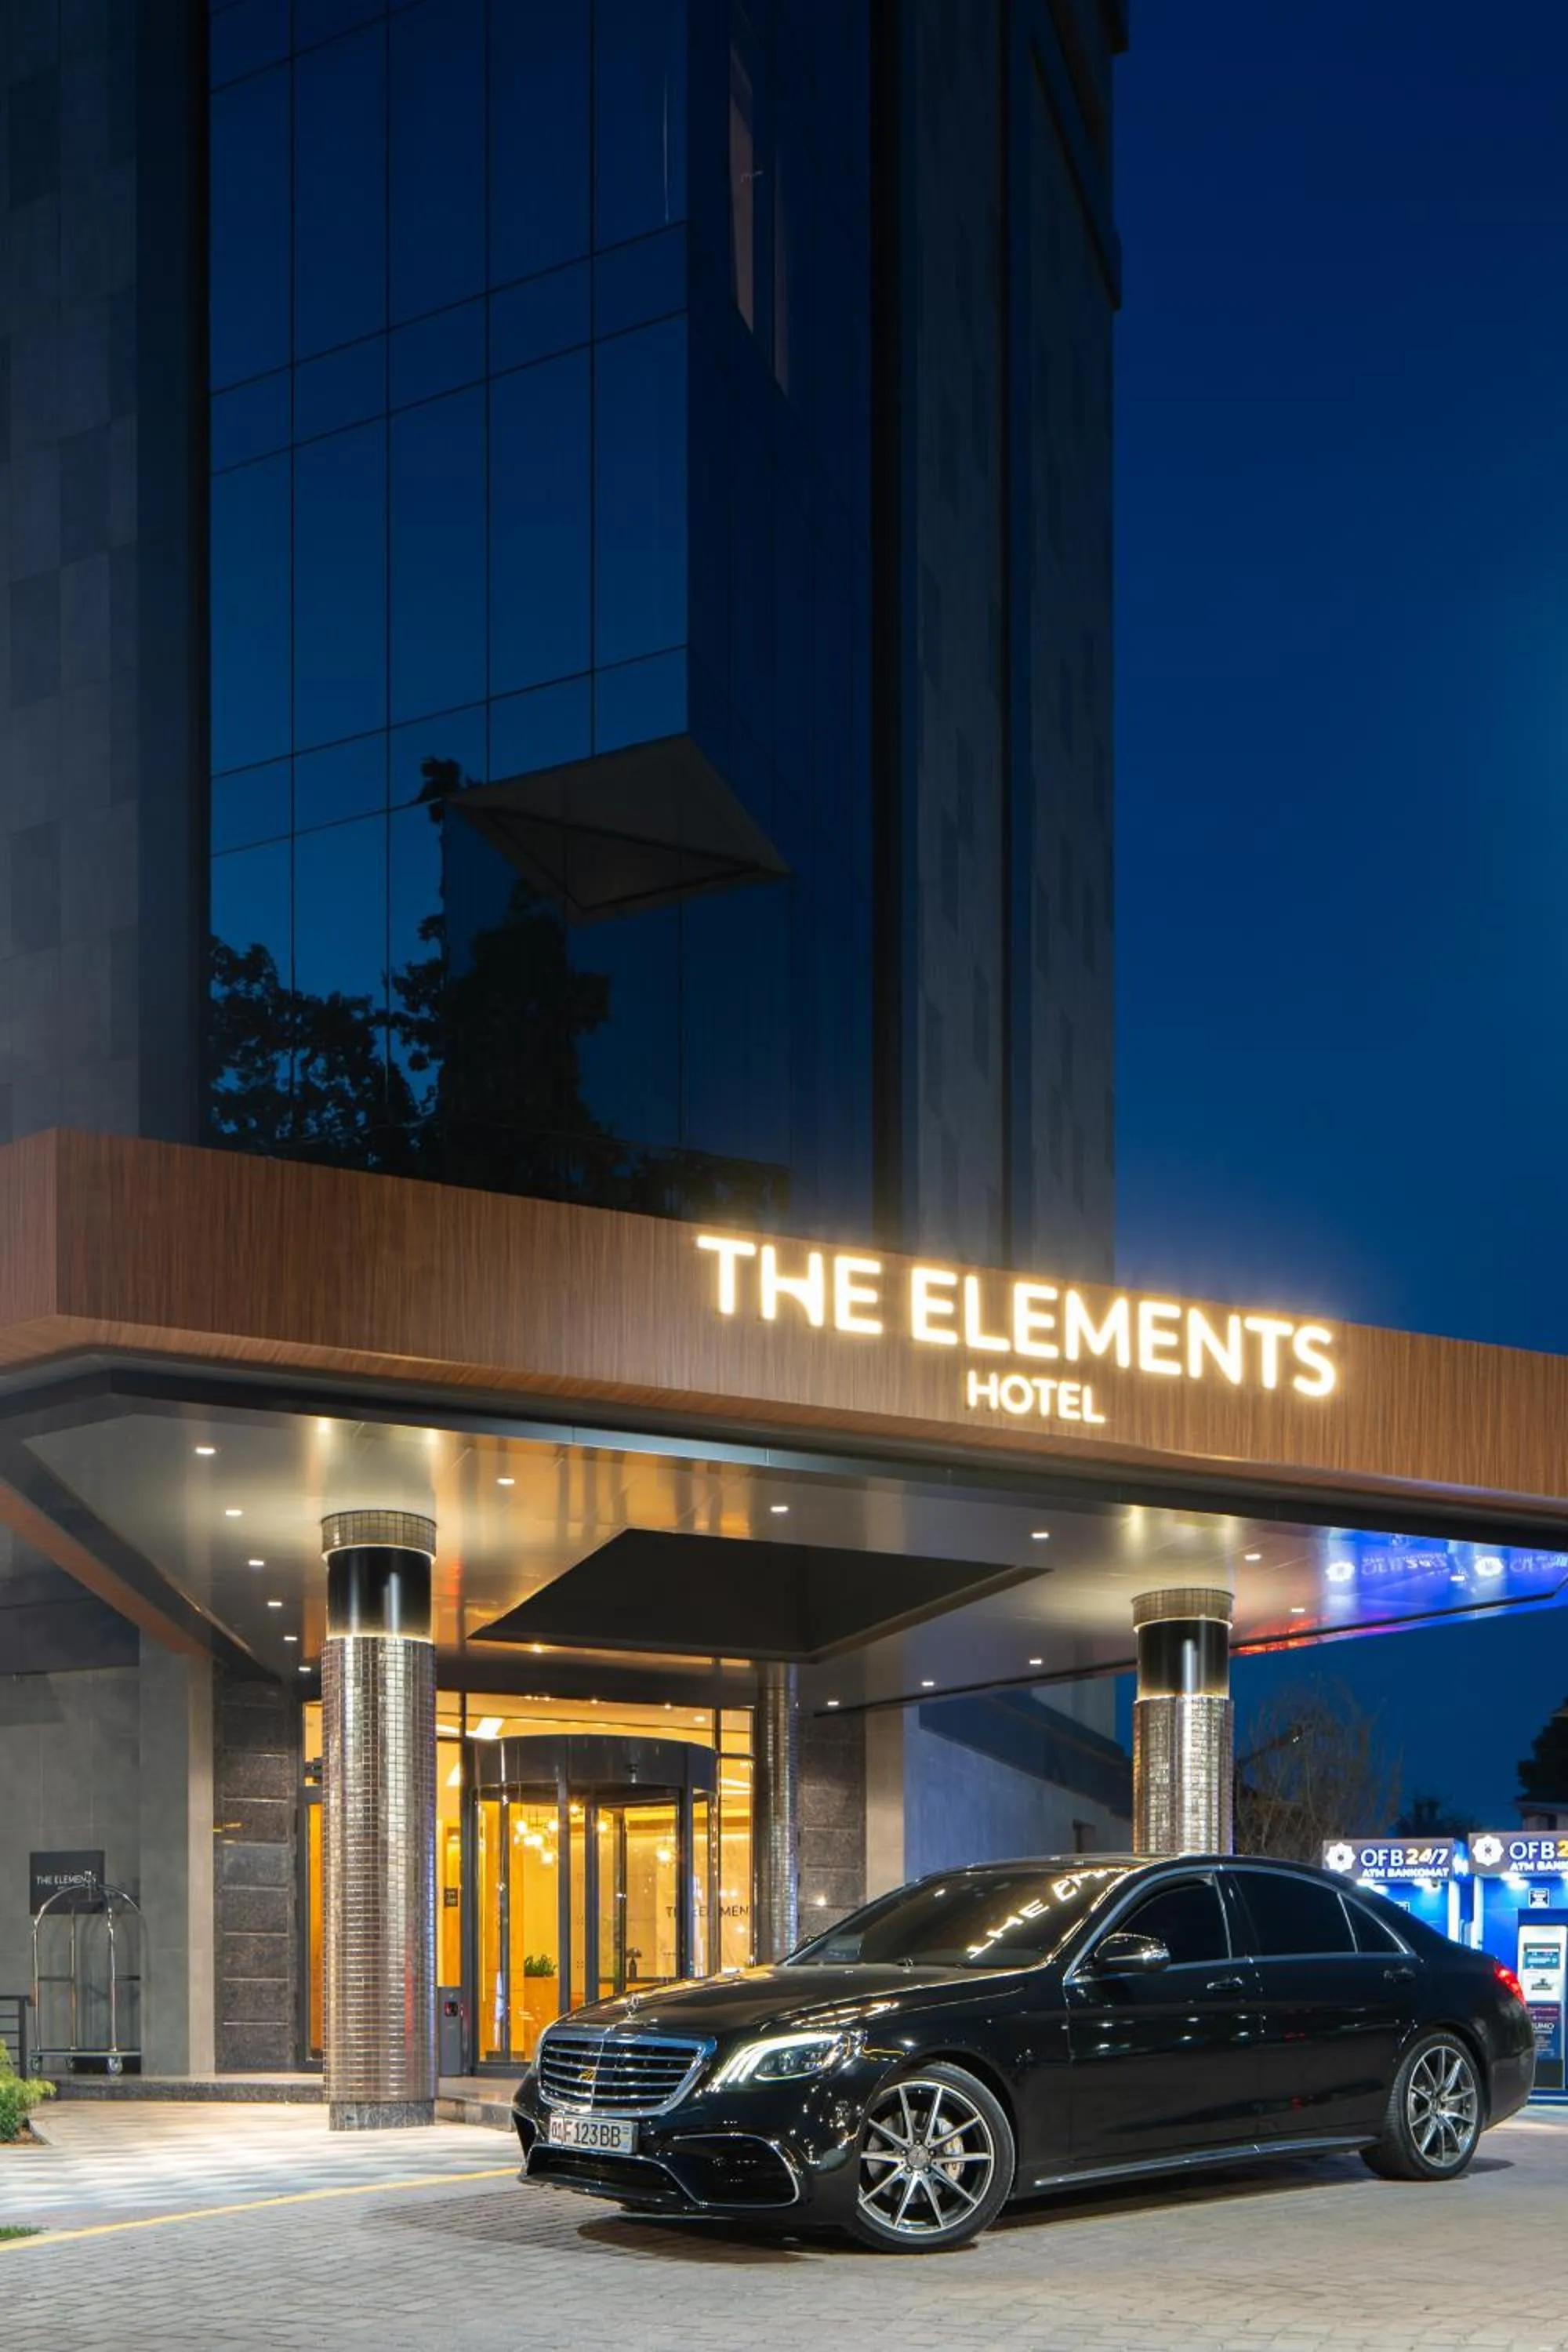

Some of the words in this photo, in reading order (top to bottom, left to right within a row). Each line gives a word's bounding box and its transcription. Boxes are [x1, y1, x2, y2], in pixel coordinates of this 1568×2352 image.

[696, 1234, 883, 1334] THE
[911, 1266, 1336, 1397] ELEMENTS
[967, 1370, 1106, 1424] HOTEL
[1360, 1848, 1404, 1867] OFB
[1405, 1847, 1449, 1865] 24/7
[1509, 1841, 1555, 1860] OFB
[1362, 1867, 1385, 1878] ATM
[1387, 1867, 1450, 1878] BANKOMAT
[1509, 1861, 1534, 1871] ATM
